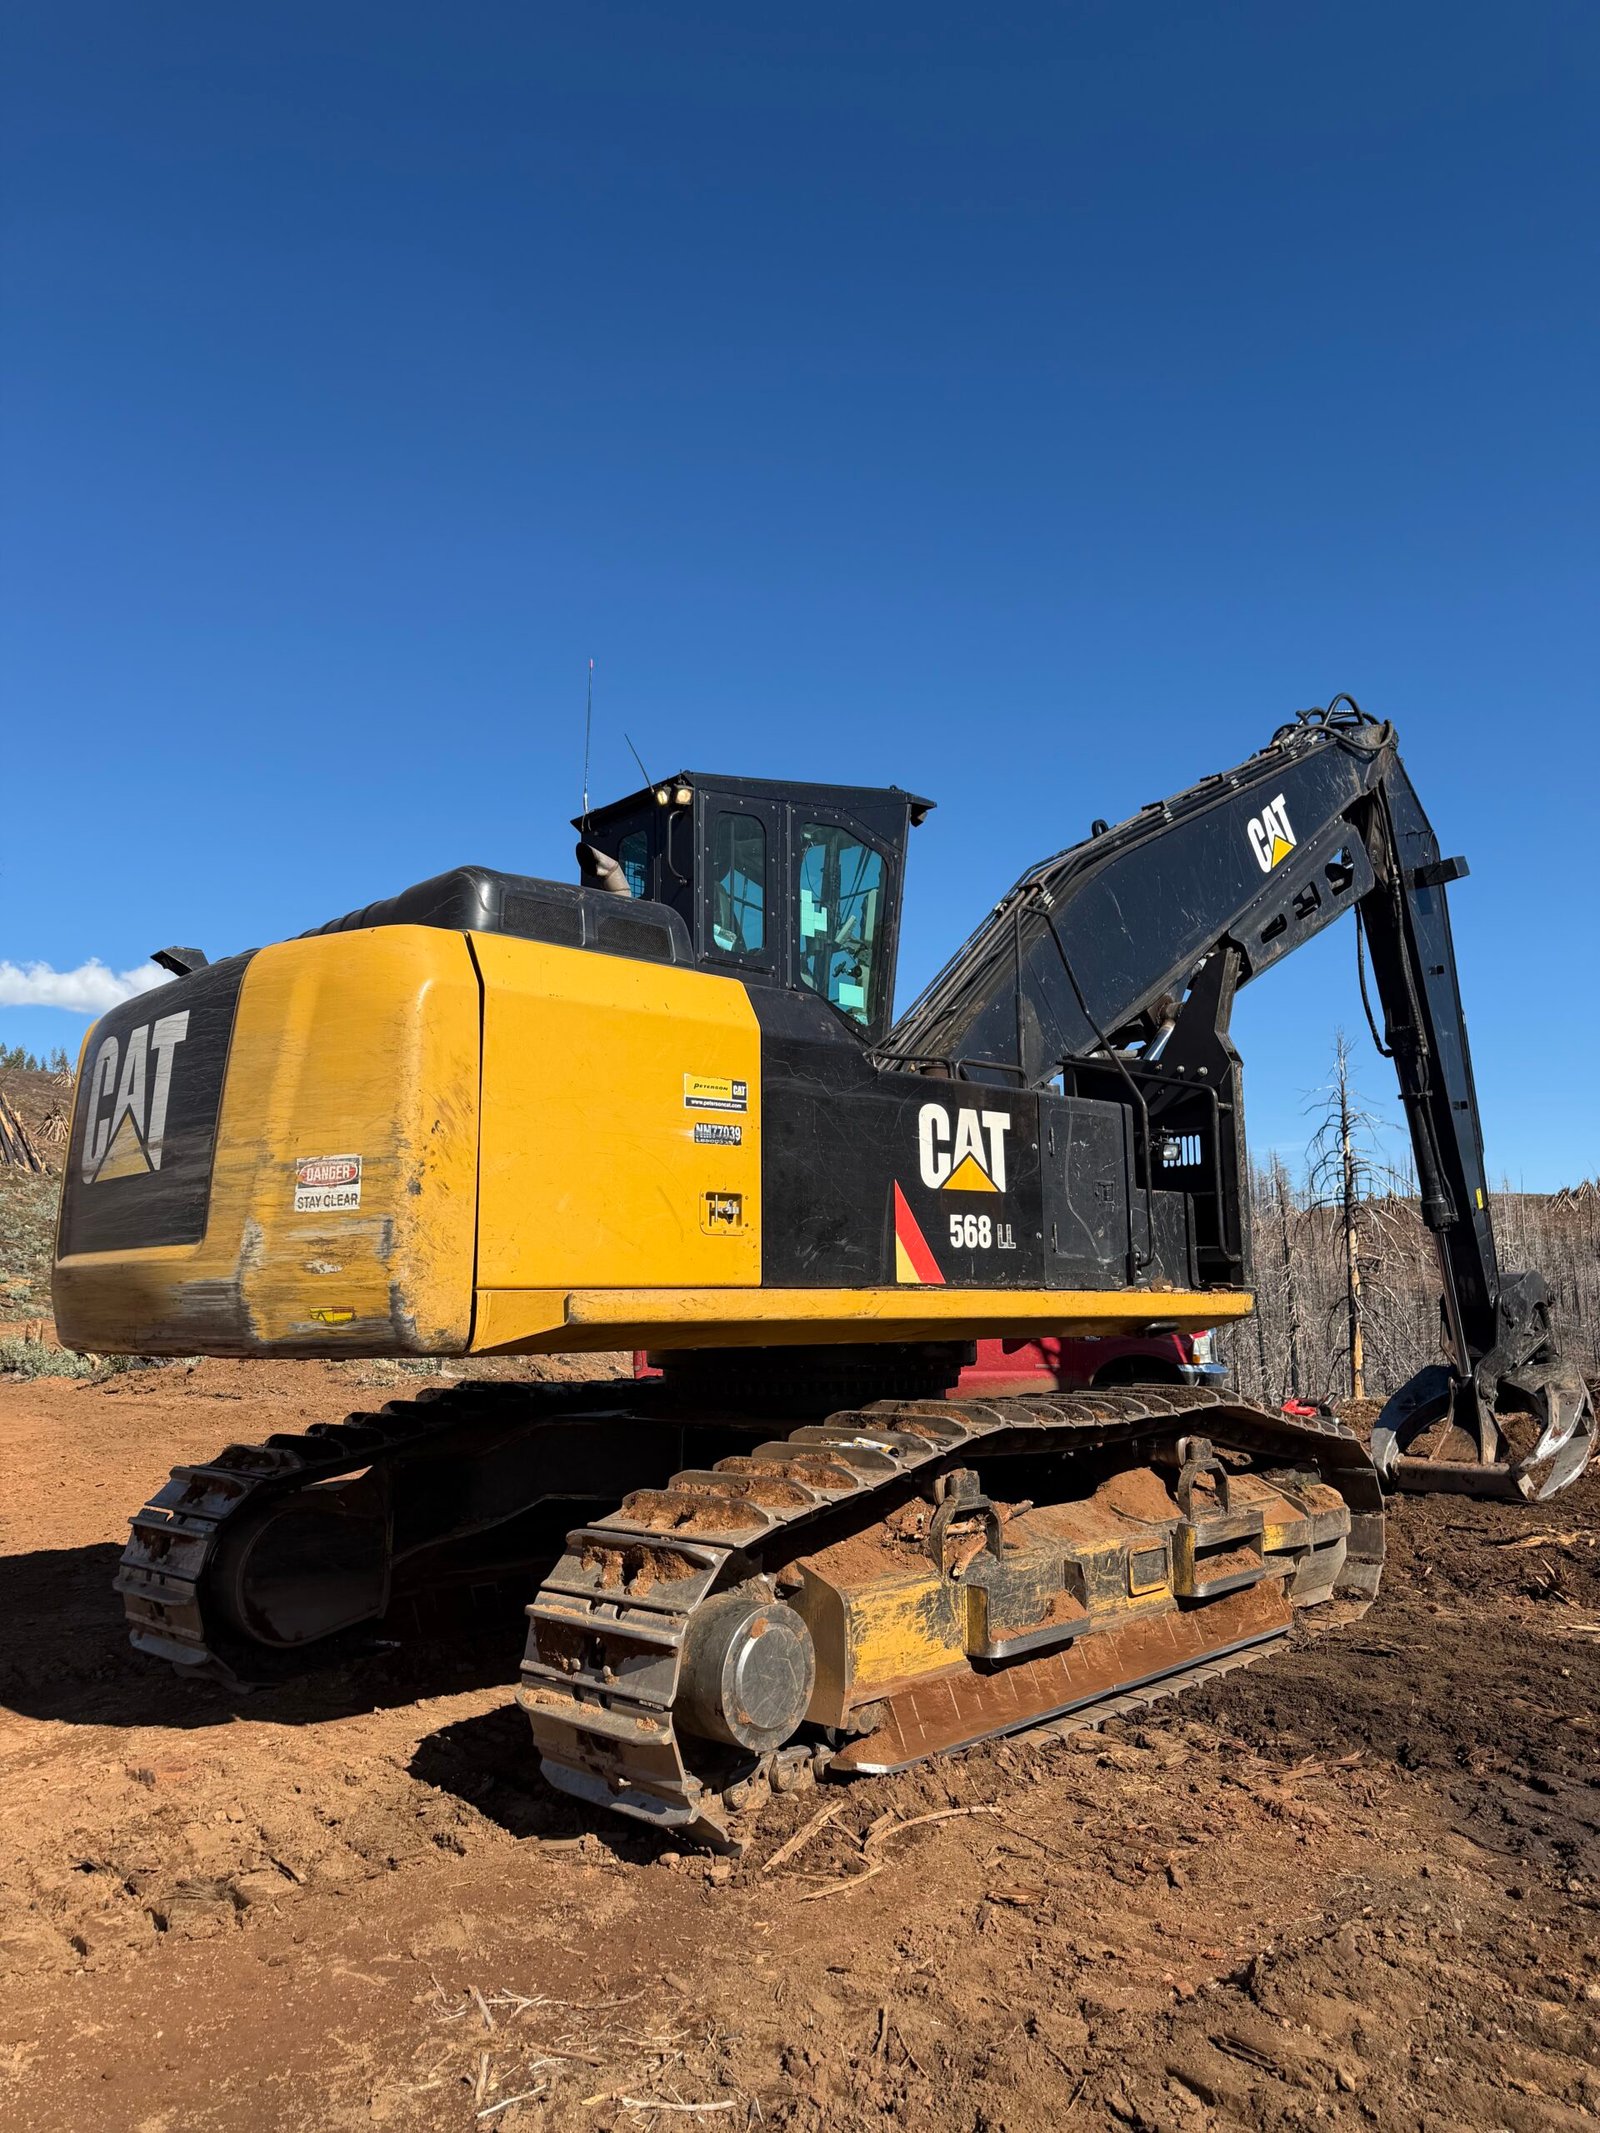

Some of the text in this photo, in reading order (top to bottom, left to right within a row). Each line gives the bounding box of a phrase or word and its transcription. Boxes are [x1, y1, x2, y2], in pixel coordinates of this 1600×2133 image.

[1247, 793, 1297, 873] CAT
[81, 1010, 190, 1185] CAT
[733, 1085, 746, 1096] CAT
[695, 1123, 741, 1141] NM77039
[918, 1103, 1011, 1193] CAT
[306, 1165, 350, 1182] DANGER
[297, 1192, 358, 1209] STAY CLEAR
[950, 1214, 1016, 1249] 568 LL
